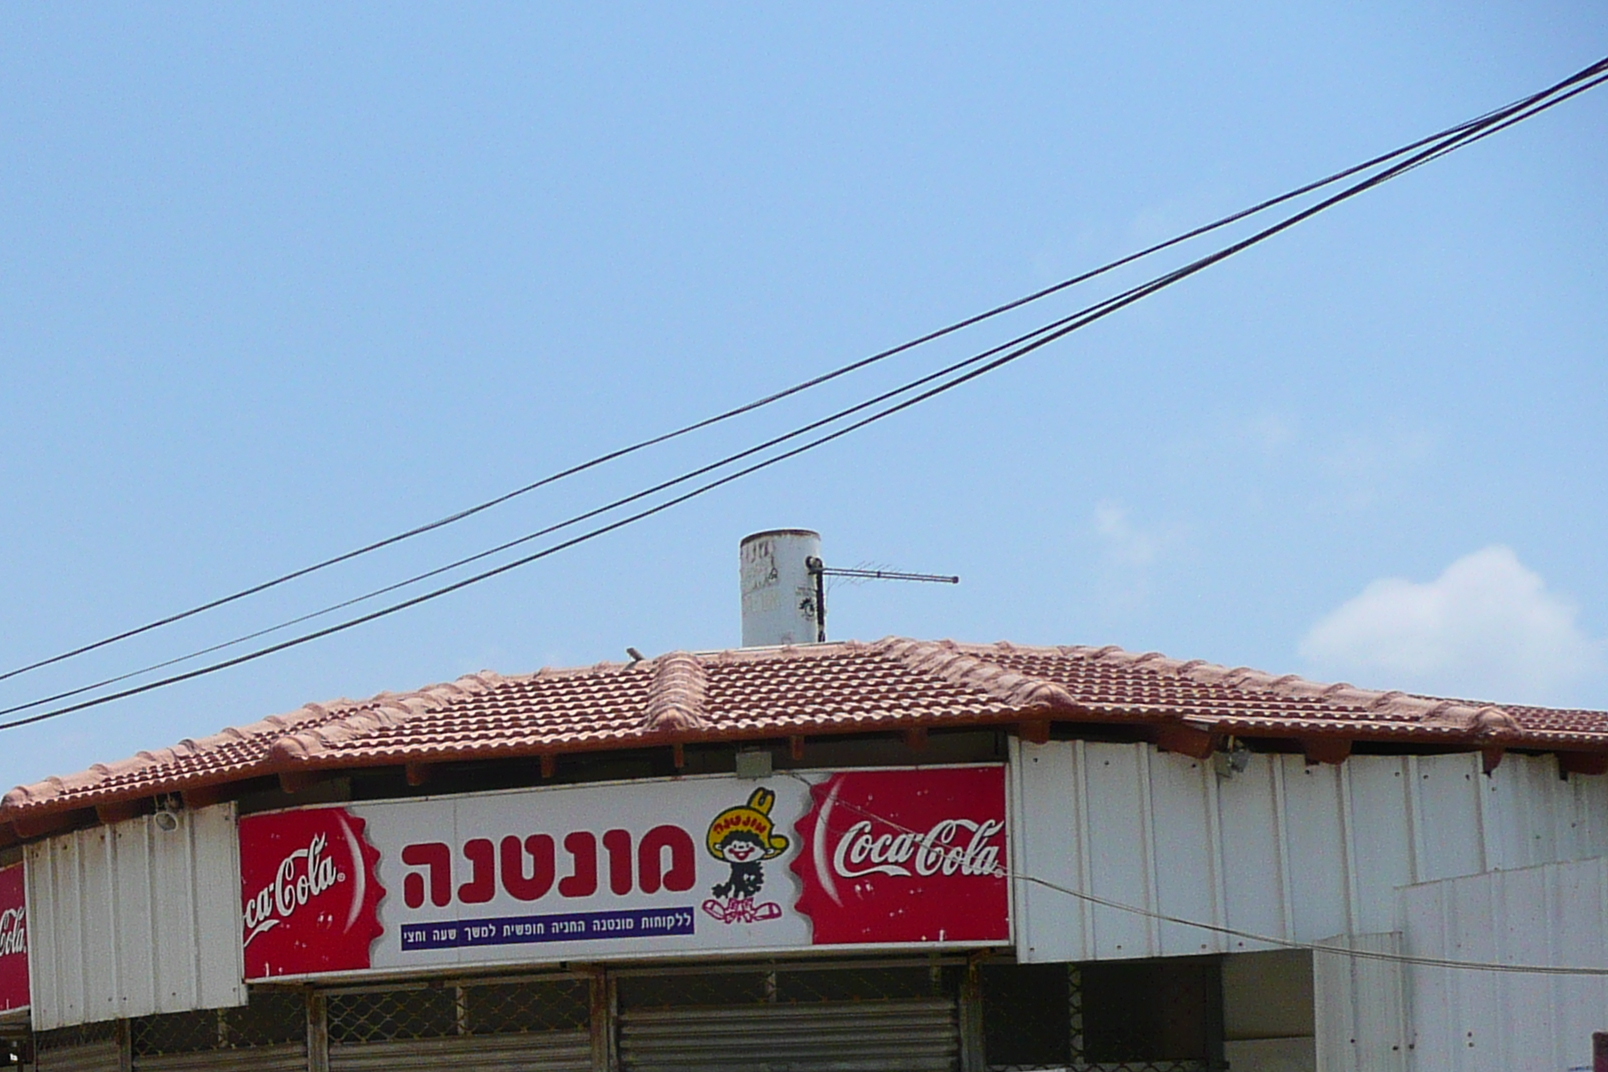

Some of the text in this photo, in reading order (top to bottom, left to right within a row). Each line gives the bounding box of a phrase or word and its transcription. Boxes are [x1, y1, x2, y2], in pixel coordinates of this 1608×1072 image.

[401, 824, 696, 908] מונטנה
[834, 818, 1005, 878] Coca-Cola
[243, 831, 337, 947] ca-Cola
[403, 912, 693, 943] ללקוחות מונטנה החניה חופשית למשך שעה וחצי
